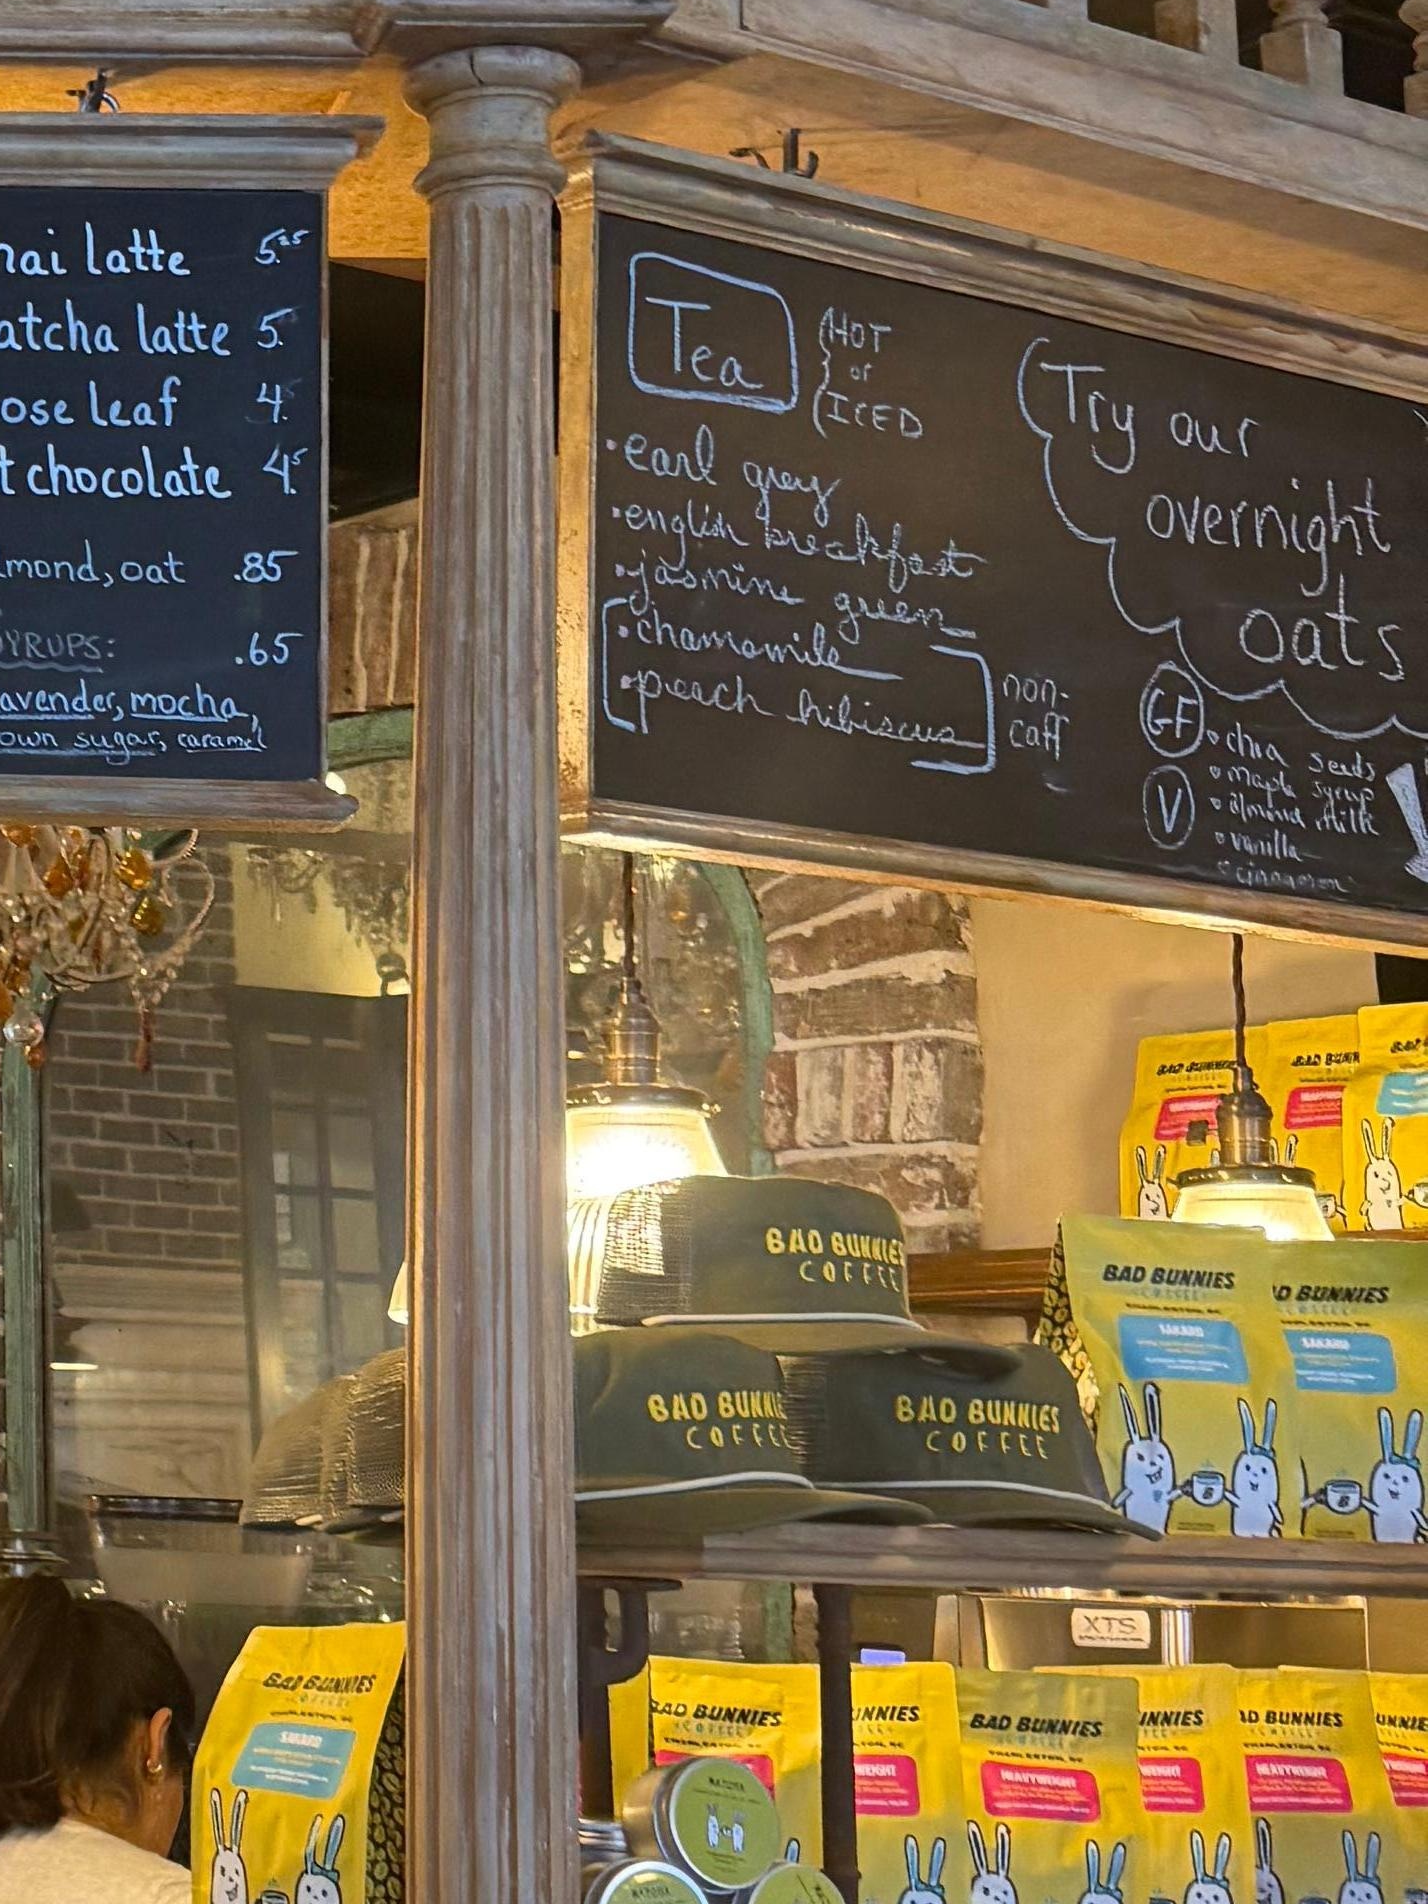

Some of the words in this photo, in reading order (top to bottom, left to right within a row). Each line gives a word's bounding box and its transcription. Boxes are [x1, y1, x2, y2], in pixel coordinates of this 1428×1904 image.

[85, 223, 191, 276] latte
[136, 303, 232, 357] latte
[644, 296, 765, 389] Tea
[828, 306, 893, 354] HOT
[89, 374, 185, 427] leaf
[1040, 361, 1139, 476] Try
[1170, 413, 1261, 459] our
[28, 442, 232, 500] chocolate
[624, 424, 717, 486] earl
[626, 498, 749, 567] english
[764, 512, 989, 593] breakfast
[1146, 476, 1392, 598] overnight
[627, 549, 805, 616] jasmine
[834, 591, 977, 644] green
[637, 602, 904, 681] chamomile
[1239, 572, 1405, 683] oats
[130, 682, 259, 729] mocha,
[629, 668, 778, 734] peach
[786, 688, 987, 749] hibiscus
[1147, 688, 1198, 739] GF
[74, 731, 167, 765] sugar,
[177, 728, 268, 752] caramel
[1008, 713, 1070, 761] caff
[1227, 722, 1291, 768] chia
[1157, 784, 1183, 834] V
[1230, 828, 1304, 863] vanilla
[765, 1227, 824, 1256] BAD
[799, 1259, 902, 1293] COFFEE
[1101, 1263, 1147, 1284] BAD
[1150, 1266, 1236, 1290] BUNNIES
[1294, 1284, 1390, 1304] BUNNIES
[647, 1393, 708, 1423] BAD
[718, 1390, 788, 1419] BUNNIE
[895, 1394, 957, 1426] BAD
[968, 1397, 1061, 1434] BUNNIES
[926, 1430, 1050, 1460] COFFEE
[692, 1703, 783, 1727] BUNNIES
[969, 1712, 1012, 1731] BAD
[1016, 1715, 1104, 1738] BUNNIES
[1264, 1709, 1344, 1728] BUNNIES
